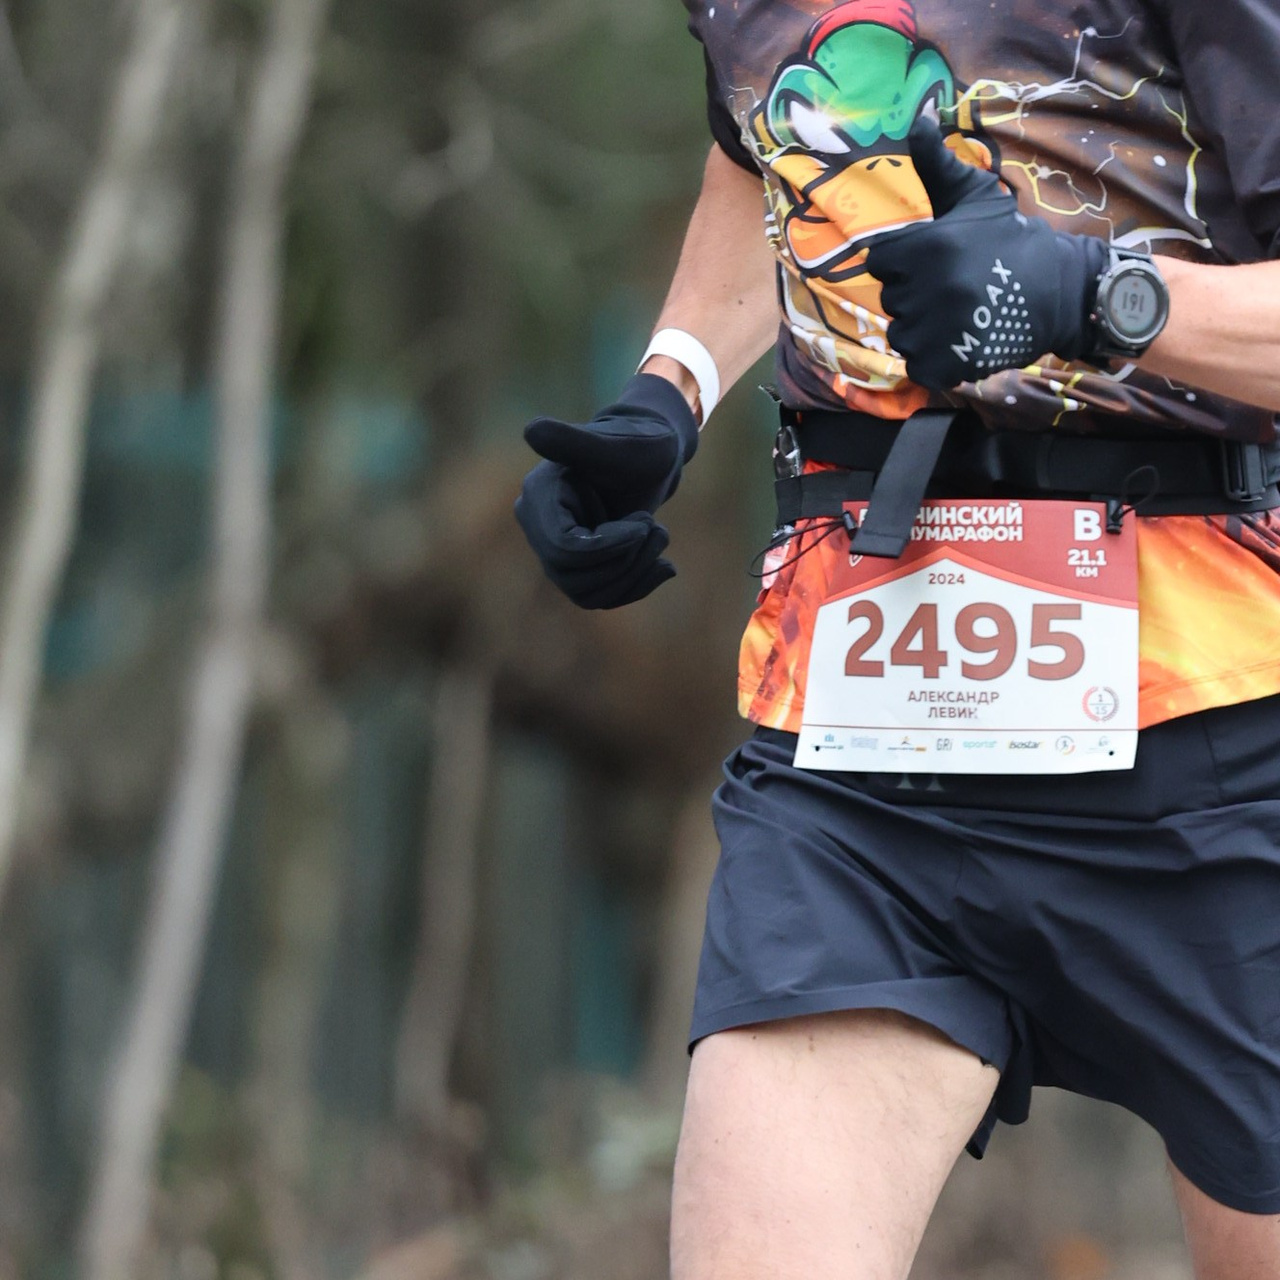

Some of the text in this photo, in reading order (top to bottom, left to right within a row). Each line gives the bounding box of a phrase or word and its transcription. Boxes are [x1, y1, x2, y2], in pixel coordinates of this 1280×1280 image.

[951, 258, 1013, 363] MOAX
[911, 525, 1023, 542] УМАРАФОН
[1067, 549, 1107, 566] 21.1
[928, 573, 966, 585] 2024
[844, 599, 1086, 682] 2495
[907, 690, 1000, 705] АЛЕКСАНДР
